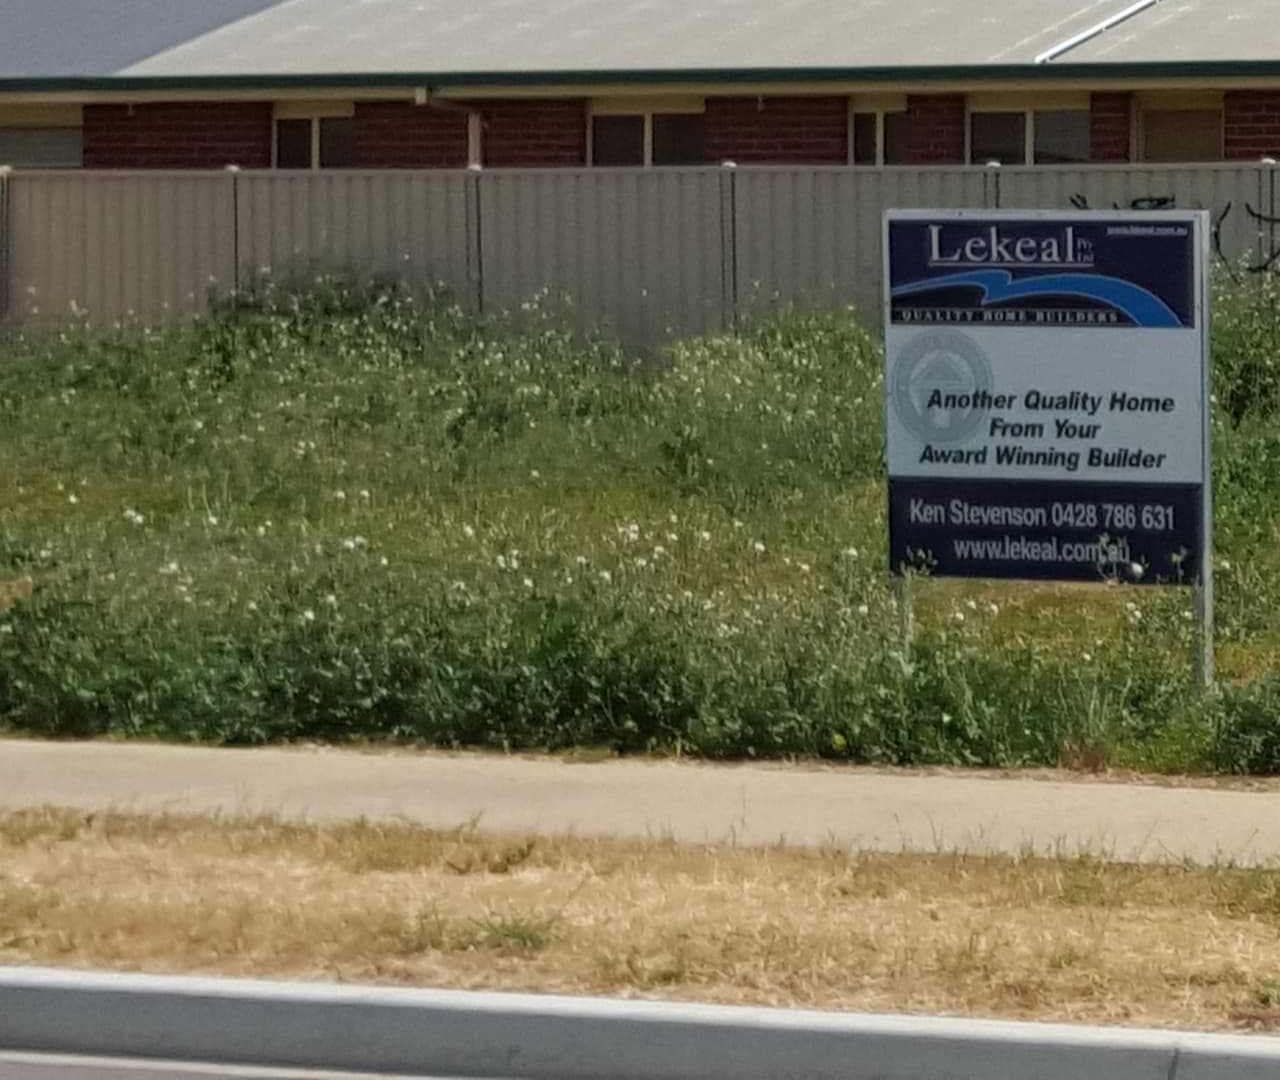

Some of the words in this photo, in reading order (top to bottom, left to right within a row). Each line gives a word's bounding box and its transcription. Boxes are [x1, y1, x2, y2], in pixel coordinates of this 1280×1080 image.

[928, 224, 1075, 263] Lekeal
[902, 311, 974, 323] QUALITY
[983, 311, 1025, 322] HOME
[1036, 311, 1118, 323] BUILDERS
[927, 389, 1017, 410] Another
[1024, 390, 1102, 415] Quality
[1109, 392, 1175, 412] Home
[989, 419, 1044, 438] From
[1054, 419, 1102, 439] Your
[919, 445, 987, 464] Award
[995, 446, 1080, 470] Winning
[1087, 449, 1166, 469] Builder
[910, 498, 945, 524] Ken
[950, 499, 1047, 526] Stevenson
[1052, 502, 1098, 528] 0428
[1103, 503, 1136, 529] 786
[1141, 505, 1174, 530] 631
